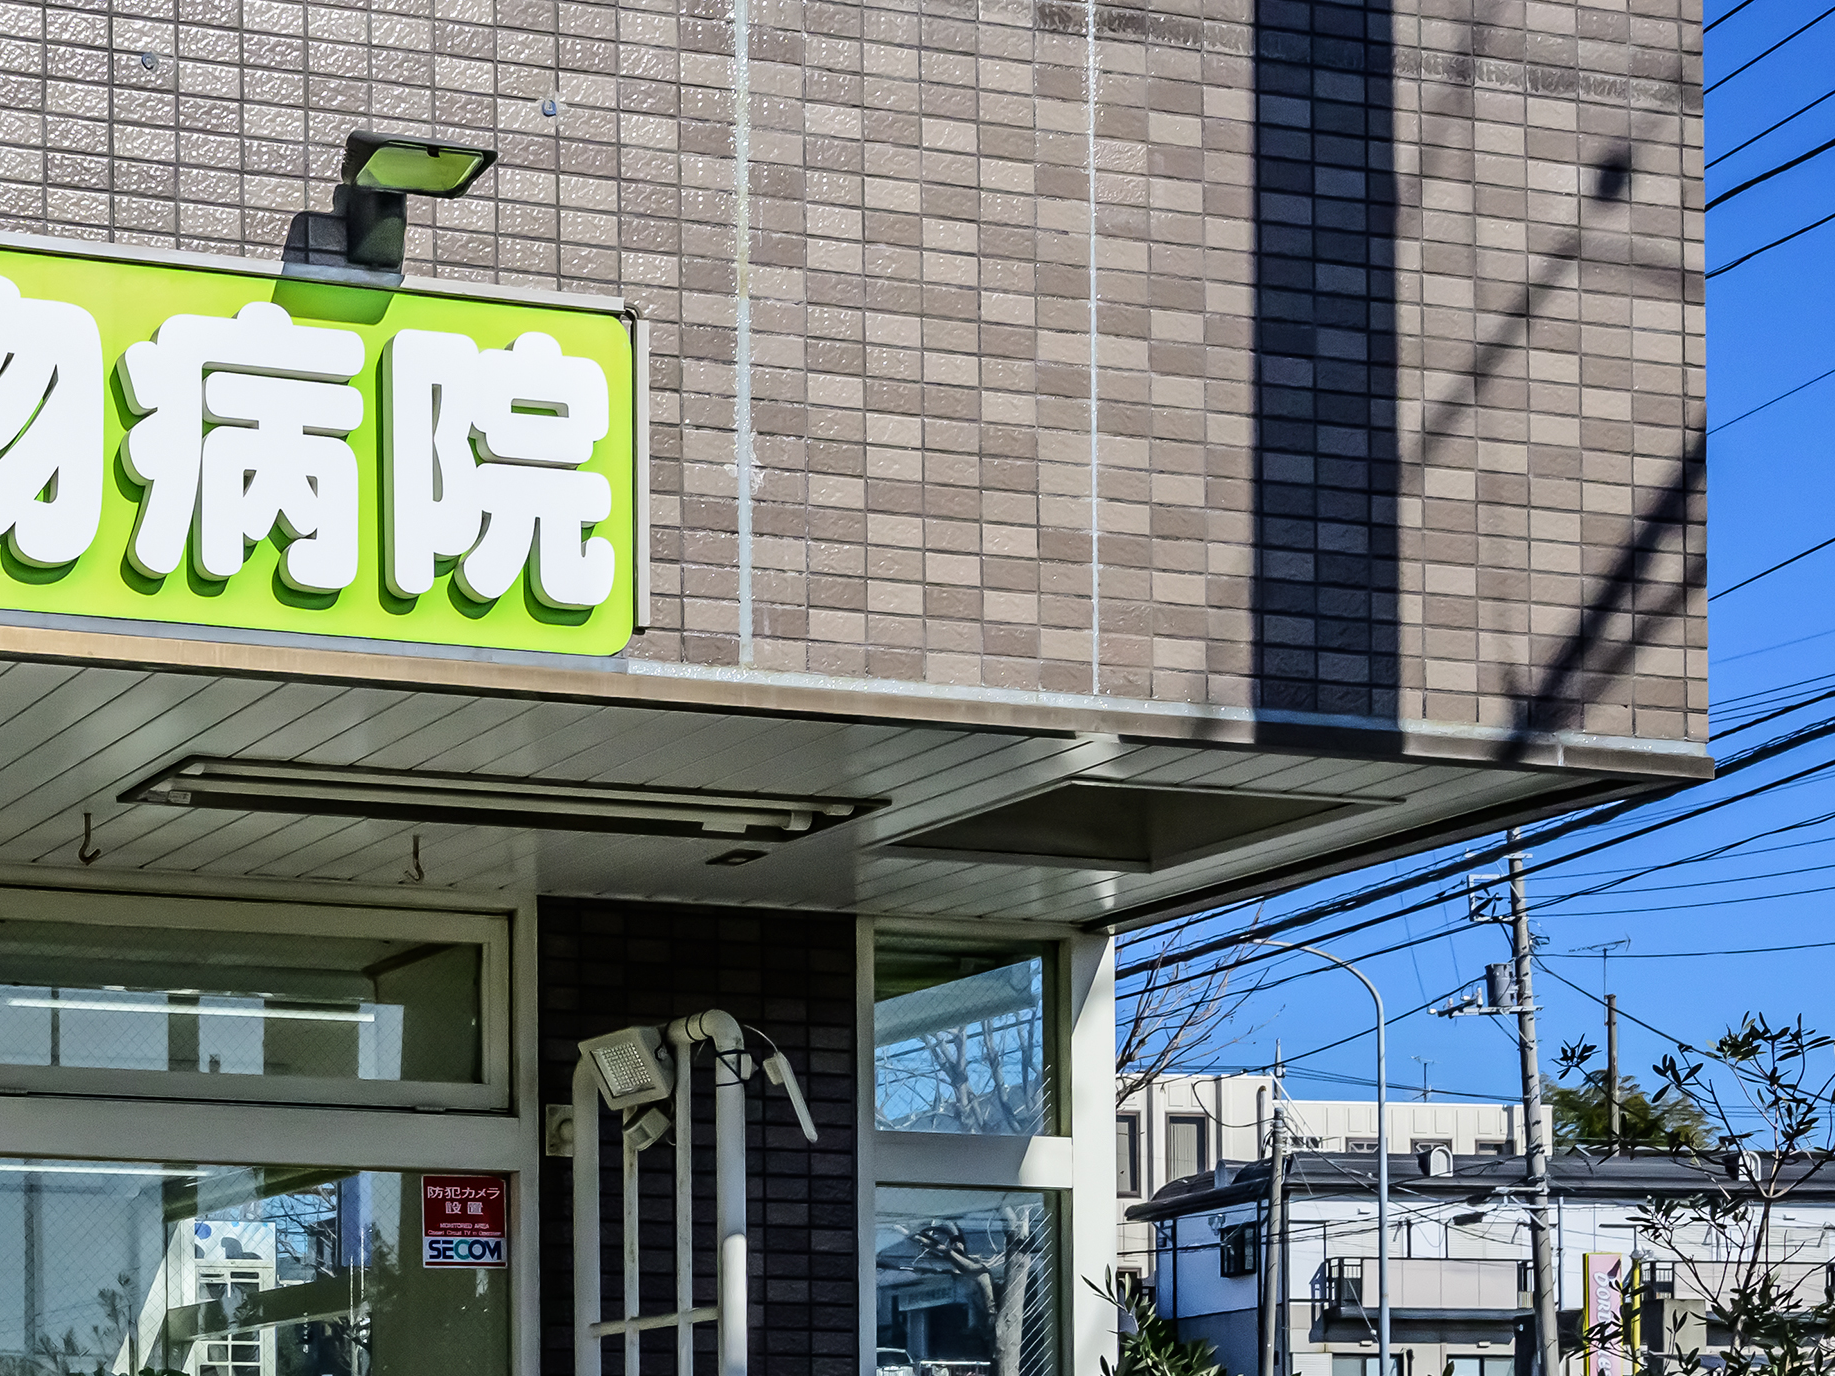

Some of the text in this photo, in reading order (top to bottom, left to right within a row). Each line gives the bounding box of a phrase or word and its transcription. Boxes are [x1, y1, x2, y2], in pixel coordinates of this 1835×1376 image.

[427, 1186, 501, 1199] 防犯カメラ
[445, 1201, 483, 1215] 設置
[428, 1239, 502, 1261] SECOM
